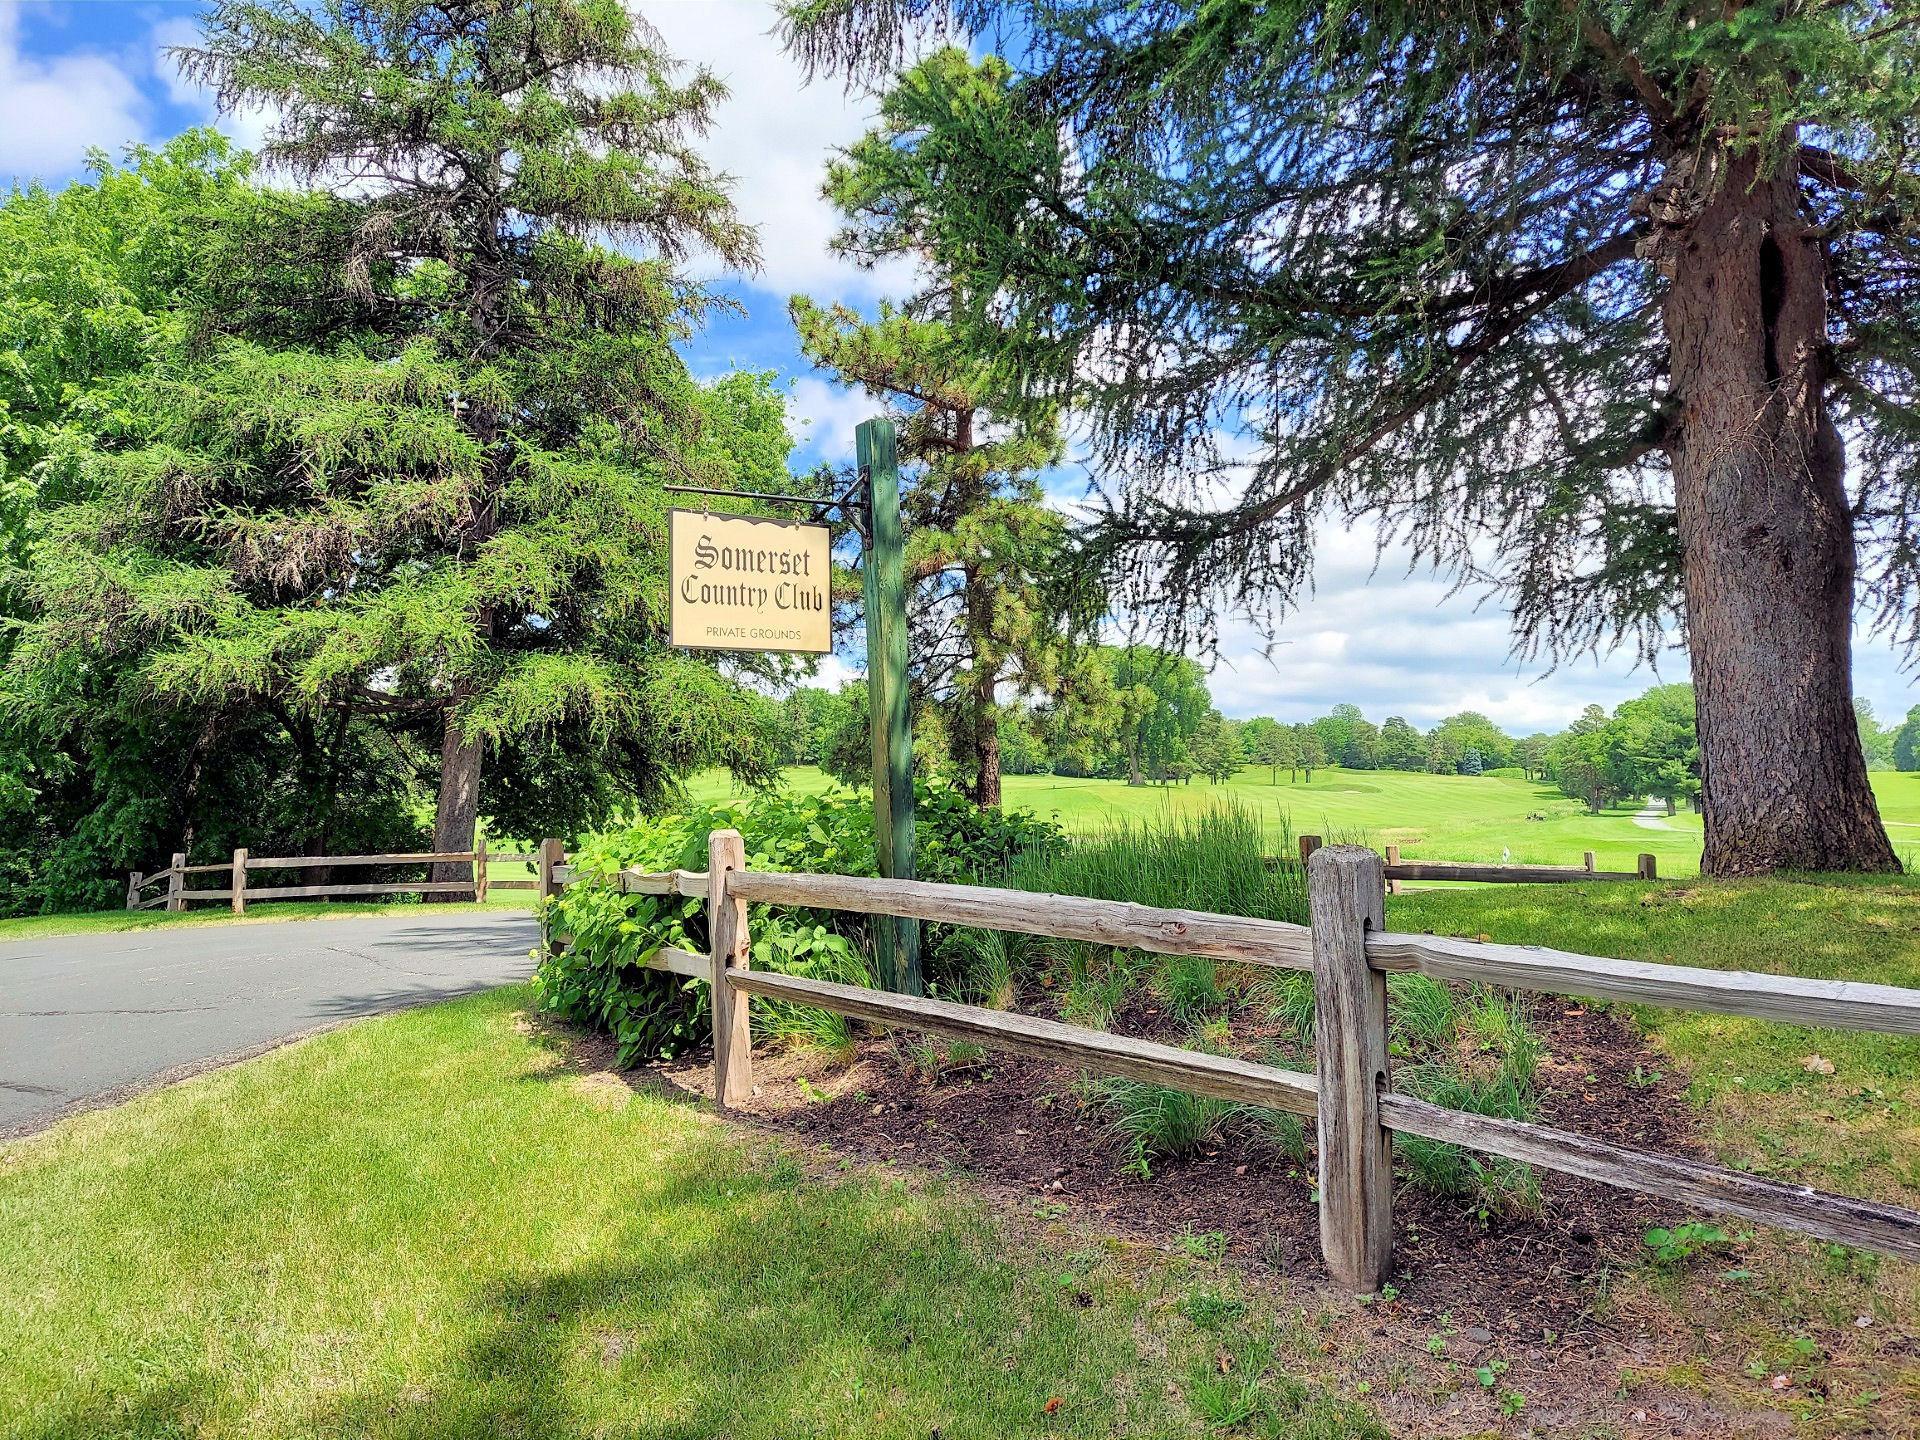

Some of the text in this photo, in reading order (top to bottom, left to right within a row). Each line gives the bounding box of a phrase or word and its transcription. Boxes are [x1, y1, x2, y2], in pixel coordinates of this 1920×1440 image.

[695, 534, 810, 577] Somerset
[681, 574, 822, 614] Country Club
[706, 627, 802, 640] PRIVATE GROUNDS
